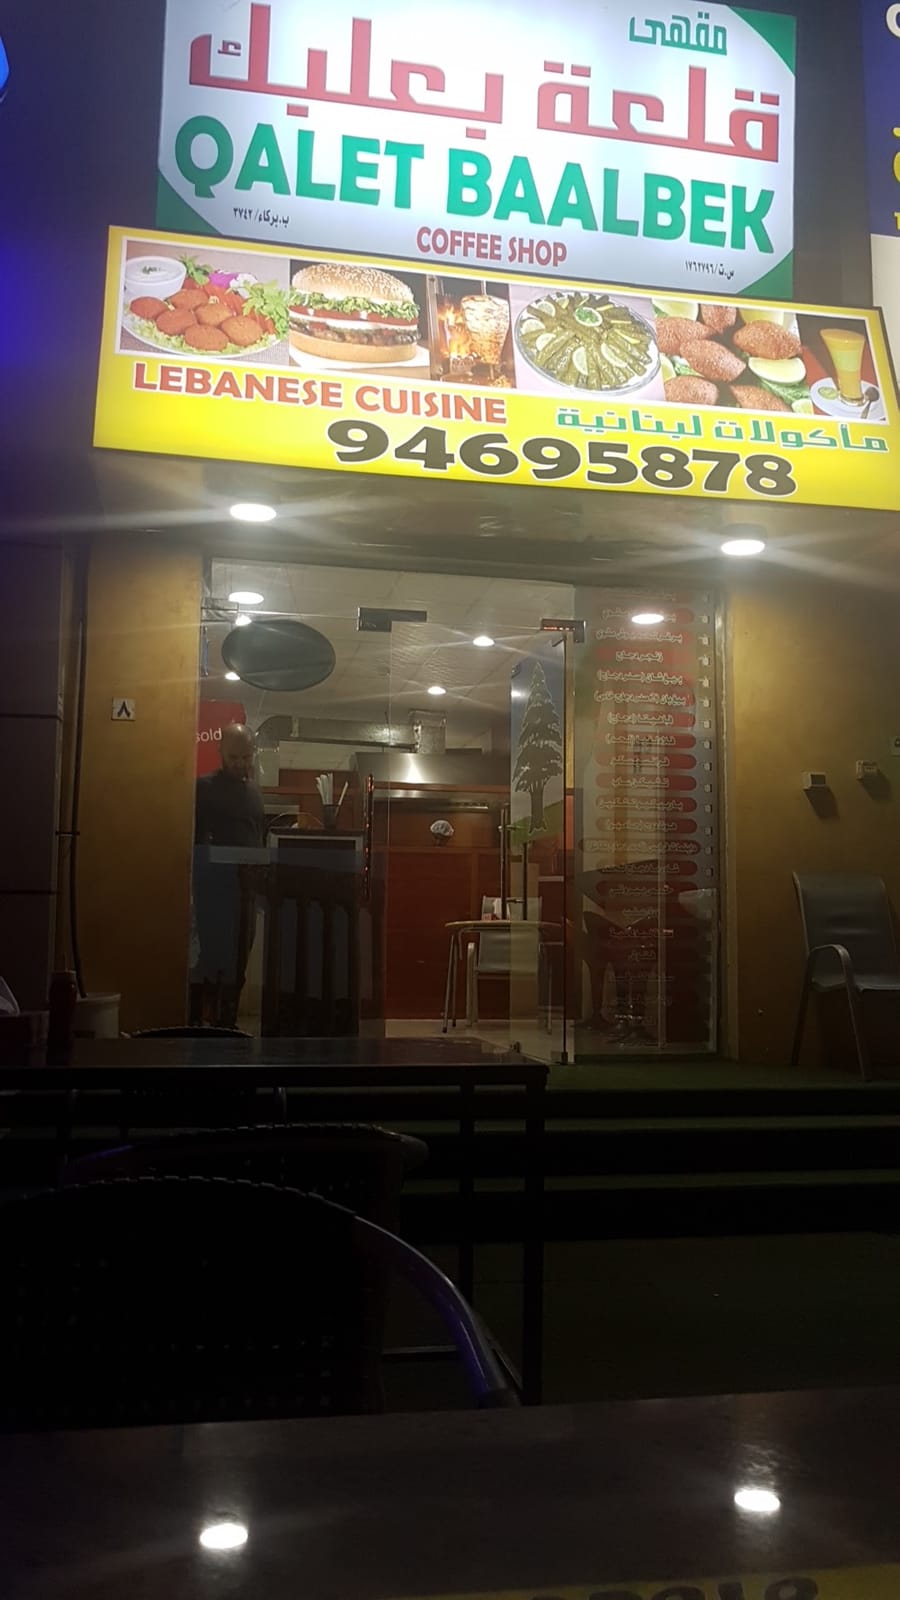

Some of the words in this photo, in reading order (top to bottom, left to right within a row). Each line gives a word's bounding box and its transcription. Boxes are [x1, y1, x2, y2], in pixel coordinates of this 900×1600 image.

[629, 11, 727, 56] مقهى
[189, 3, 504, 140] بعلبك
[537, 60, 780, 163] قلعة
[174, 115, 424, 209] QALET
[446, 149, 776, 255] BAALBEK
[416, 226, 503, 260] COFFEE
[508, 237, 567, 268] SHOP
[132, 363, 343, 410] LEBANESE
[355, 384, 507, 424] CUISINE
[556, 407, 703, 439] لبنانية
[326, 418, 797, 498] 94695878
[714, 419, 889, 452] مأكولات
